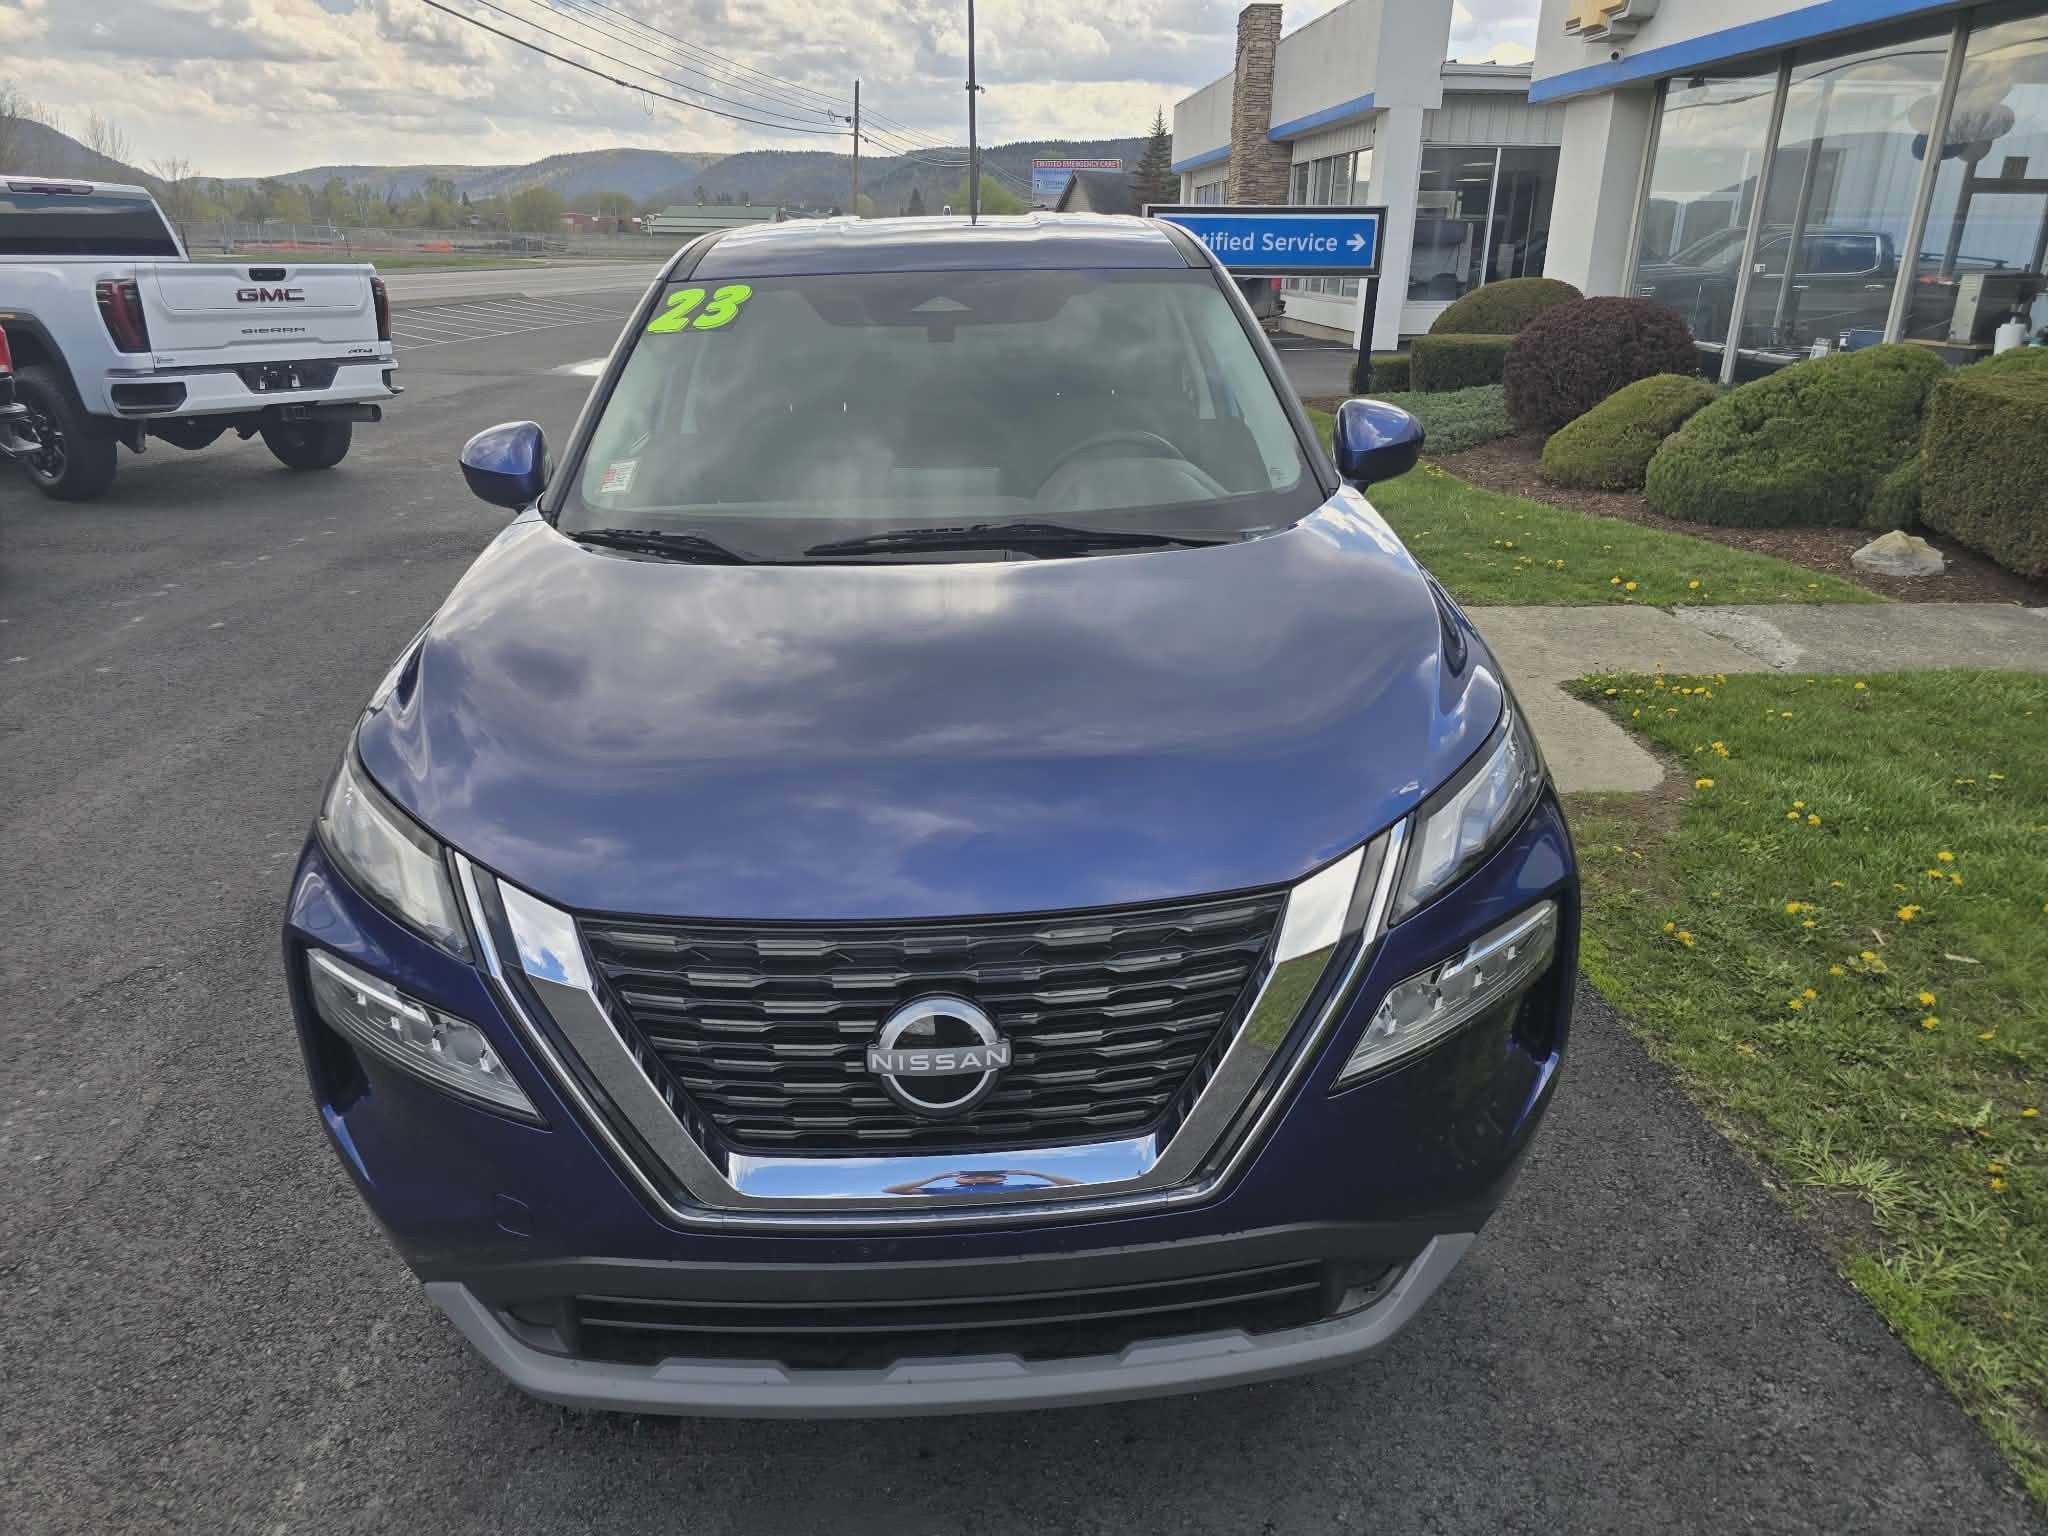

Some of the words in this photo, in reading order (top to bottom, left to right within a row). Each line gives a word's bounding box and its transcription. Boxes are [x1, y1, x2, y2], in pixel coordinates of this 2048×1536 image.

[1262, 232, 1338, 251] Service
[236, 288, 305, 302] GMC
[647, 284, 753, 333] 23
[241, 327, 306, 335] SIERRA
[871, 1047, 1007, 1071] NISSAN
